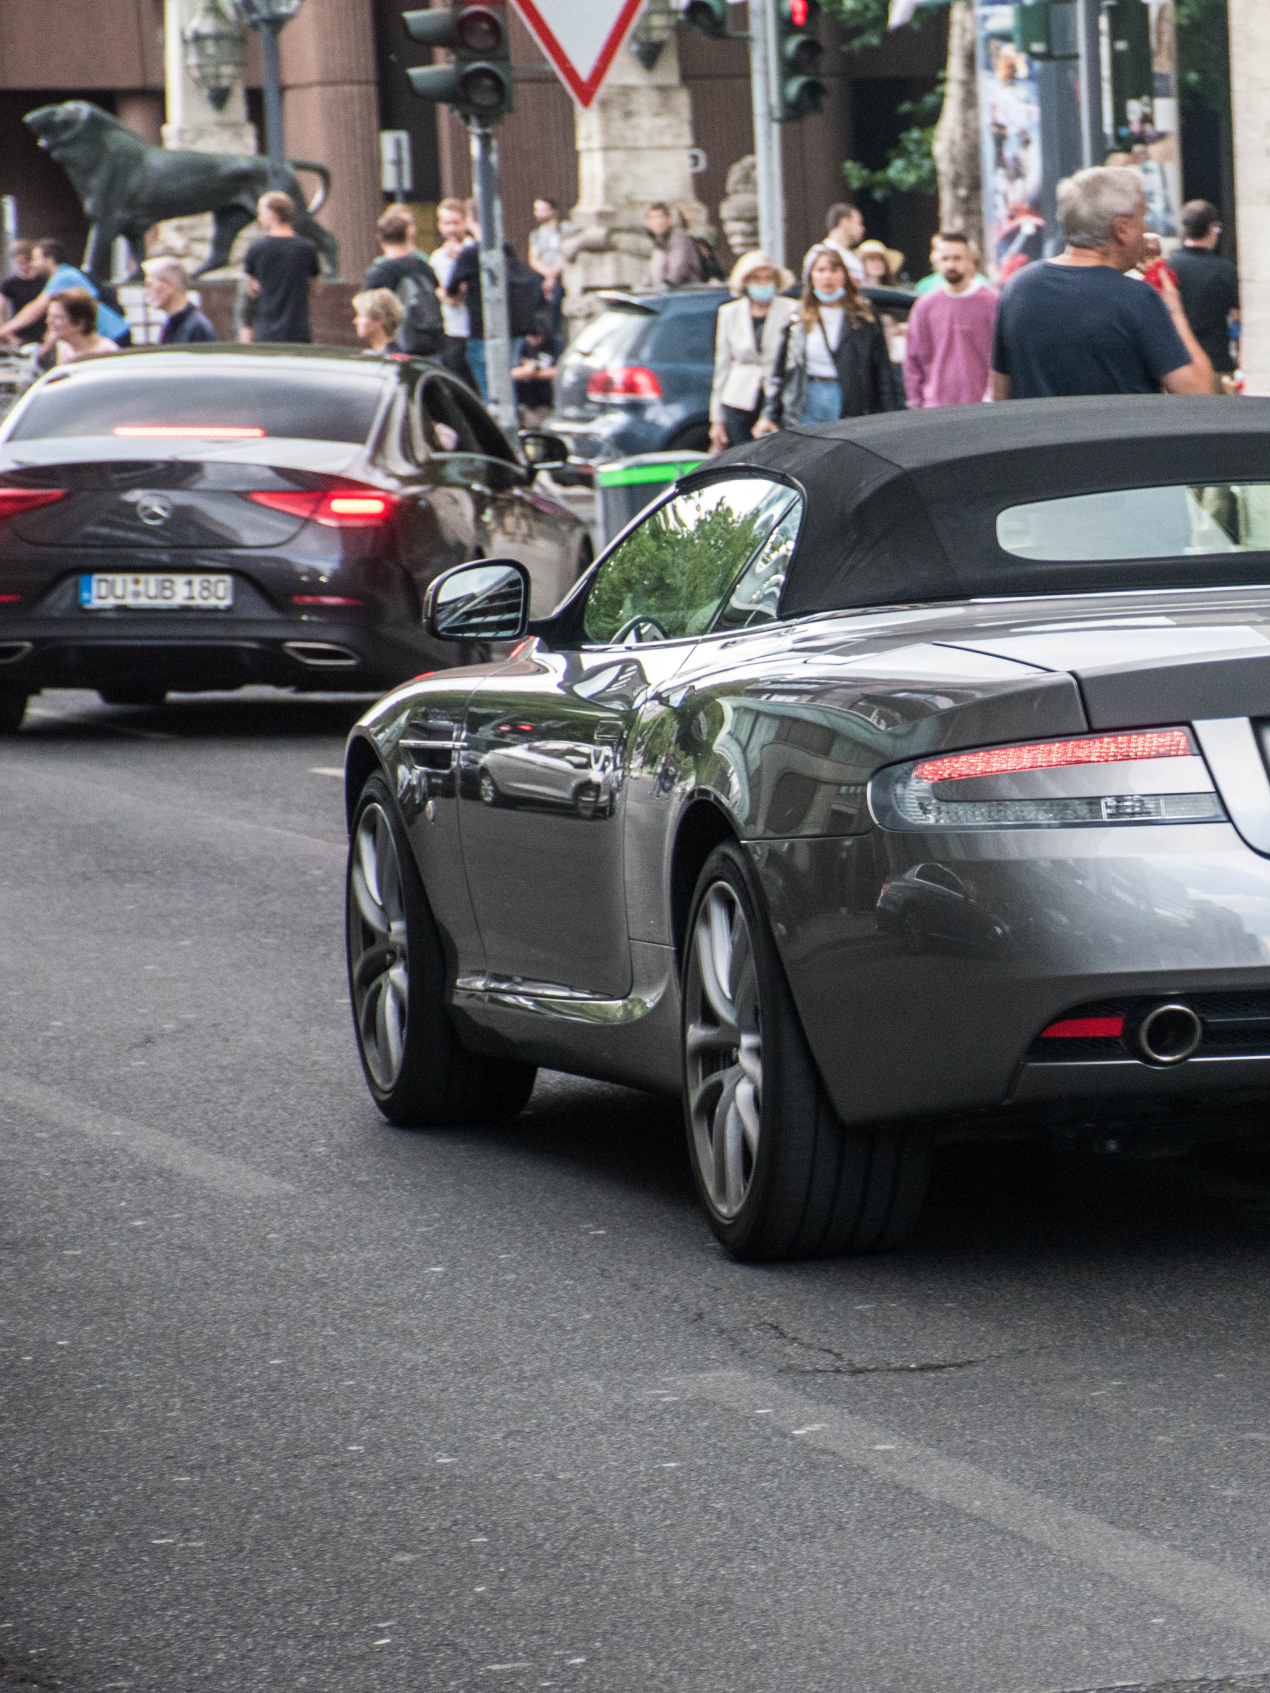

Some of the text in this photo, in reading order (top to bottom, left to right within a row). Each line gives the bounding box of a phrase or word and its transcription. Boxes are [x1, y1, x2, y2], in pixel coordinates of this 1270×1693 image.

[96, 578, 229, 600] DU UB 180
